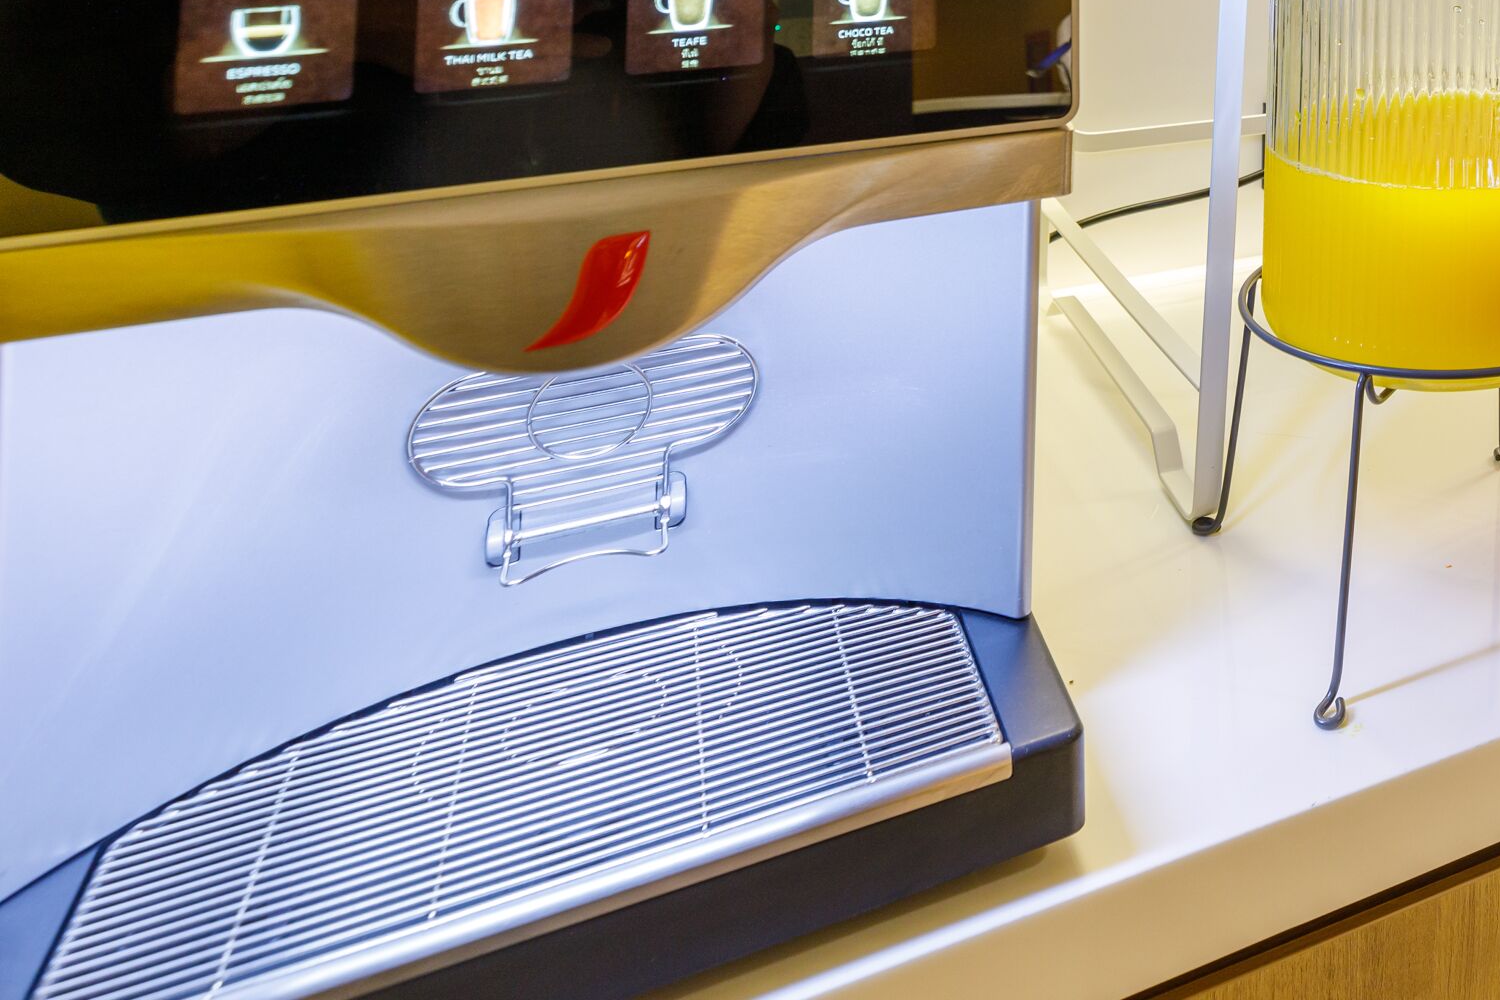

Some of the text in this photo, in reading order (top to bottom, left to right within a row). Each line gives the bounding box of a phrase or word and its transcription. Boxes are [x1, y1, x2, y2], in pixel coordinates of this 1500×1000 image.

[838, 26, 894, 39] CHOCO TEA
[672, 36, 709, 48] TEAFE
[444, 49, 534, 66] THAI MILK TEA
[226, 63, 301, 80] ESPRESSO
